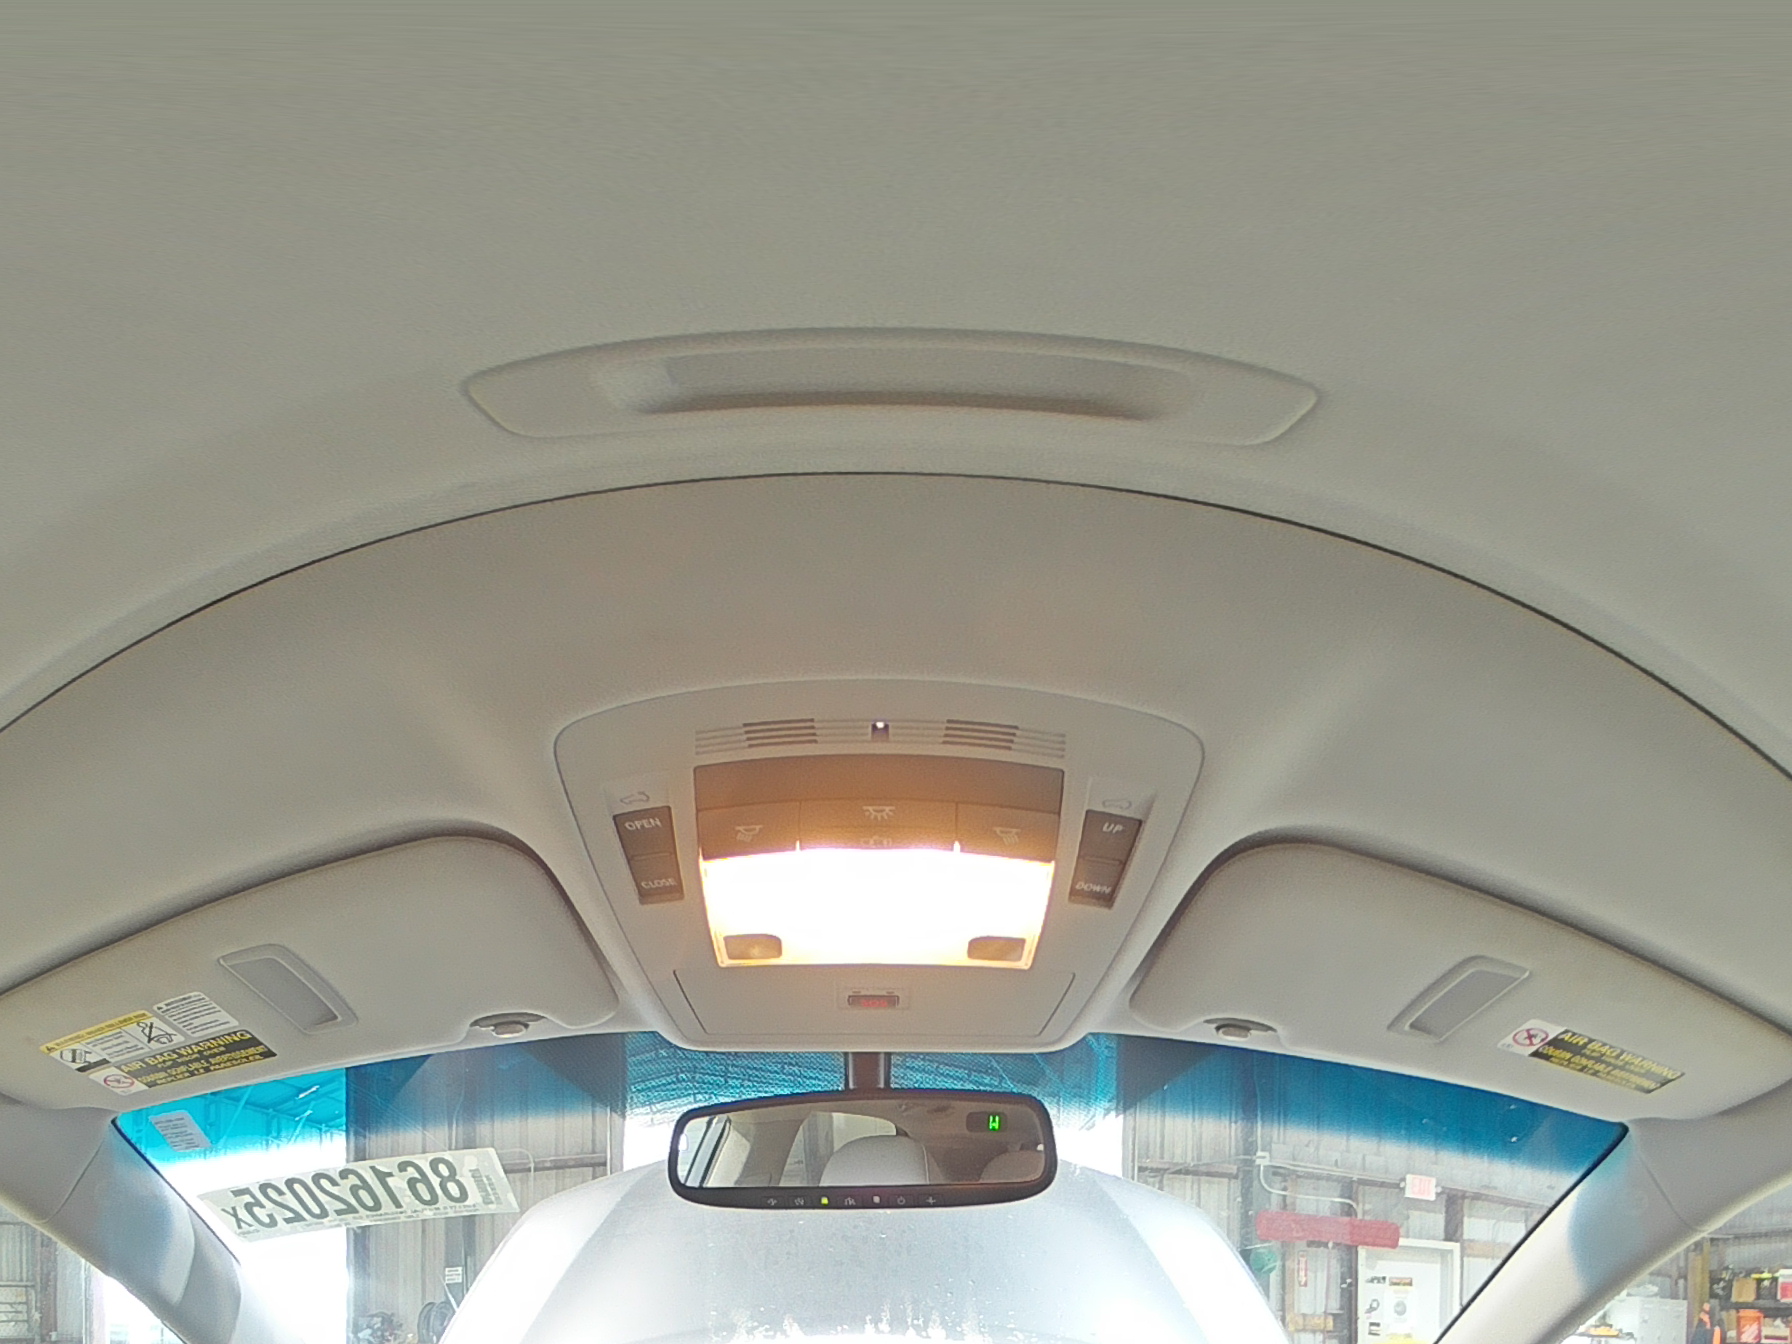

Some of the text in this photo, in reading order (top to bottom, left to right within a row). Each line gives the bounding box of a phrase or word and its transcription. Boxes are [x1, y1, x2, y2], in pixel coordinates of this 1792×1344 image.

[624, 817, 662, 831] OPEN
[1102, 822, 1124, 834] UP
[641, 877, 678, 890] CLOSE
[1075, 880, 1113, 894] DOWN
[1558, 1031, 1589, 1047] AIR
[120, 1030, 252, 1073] AIR BAG WARNING
